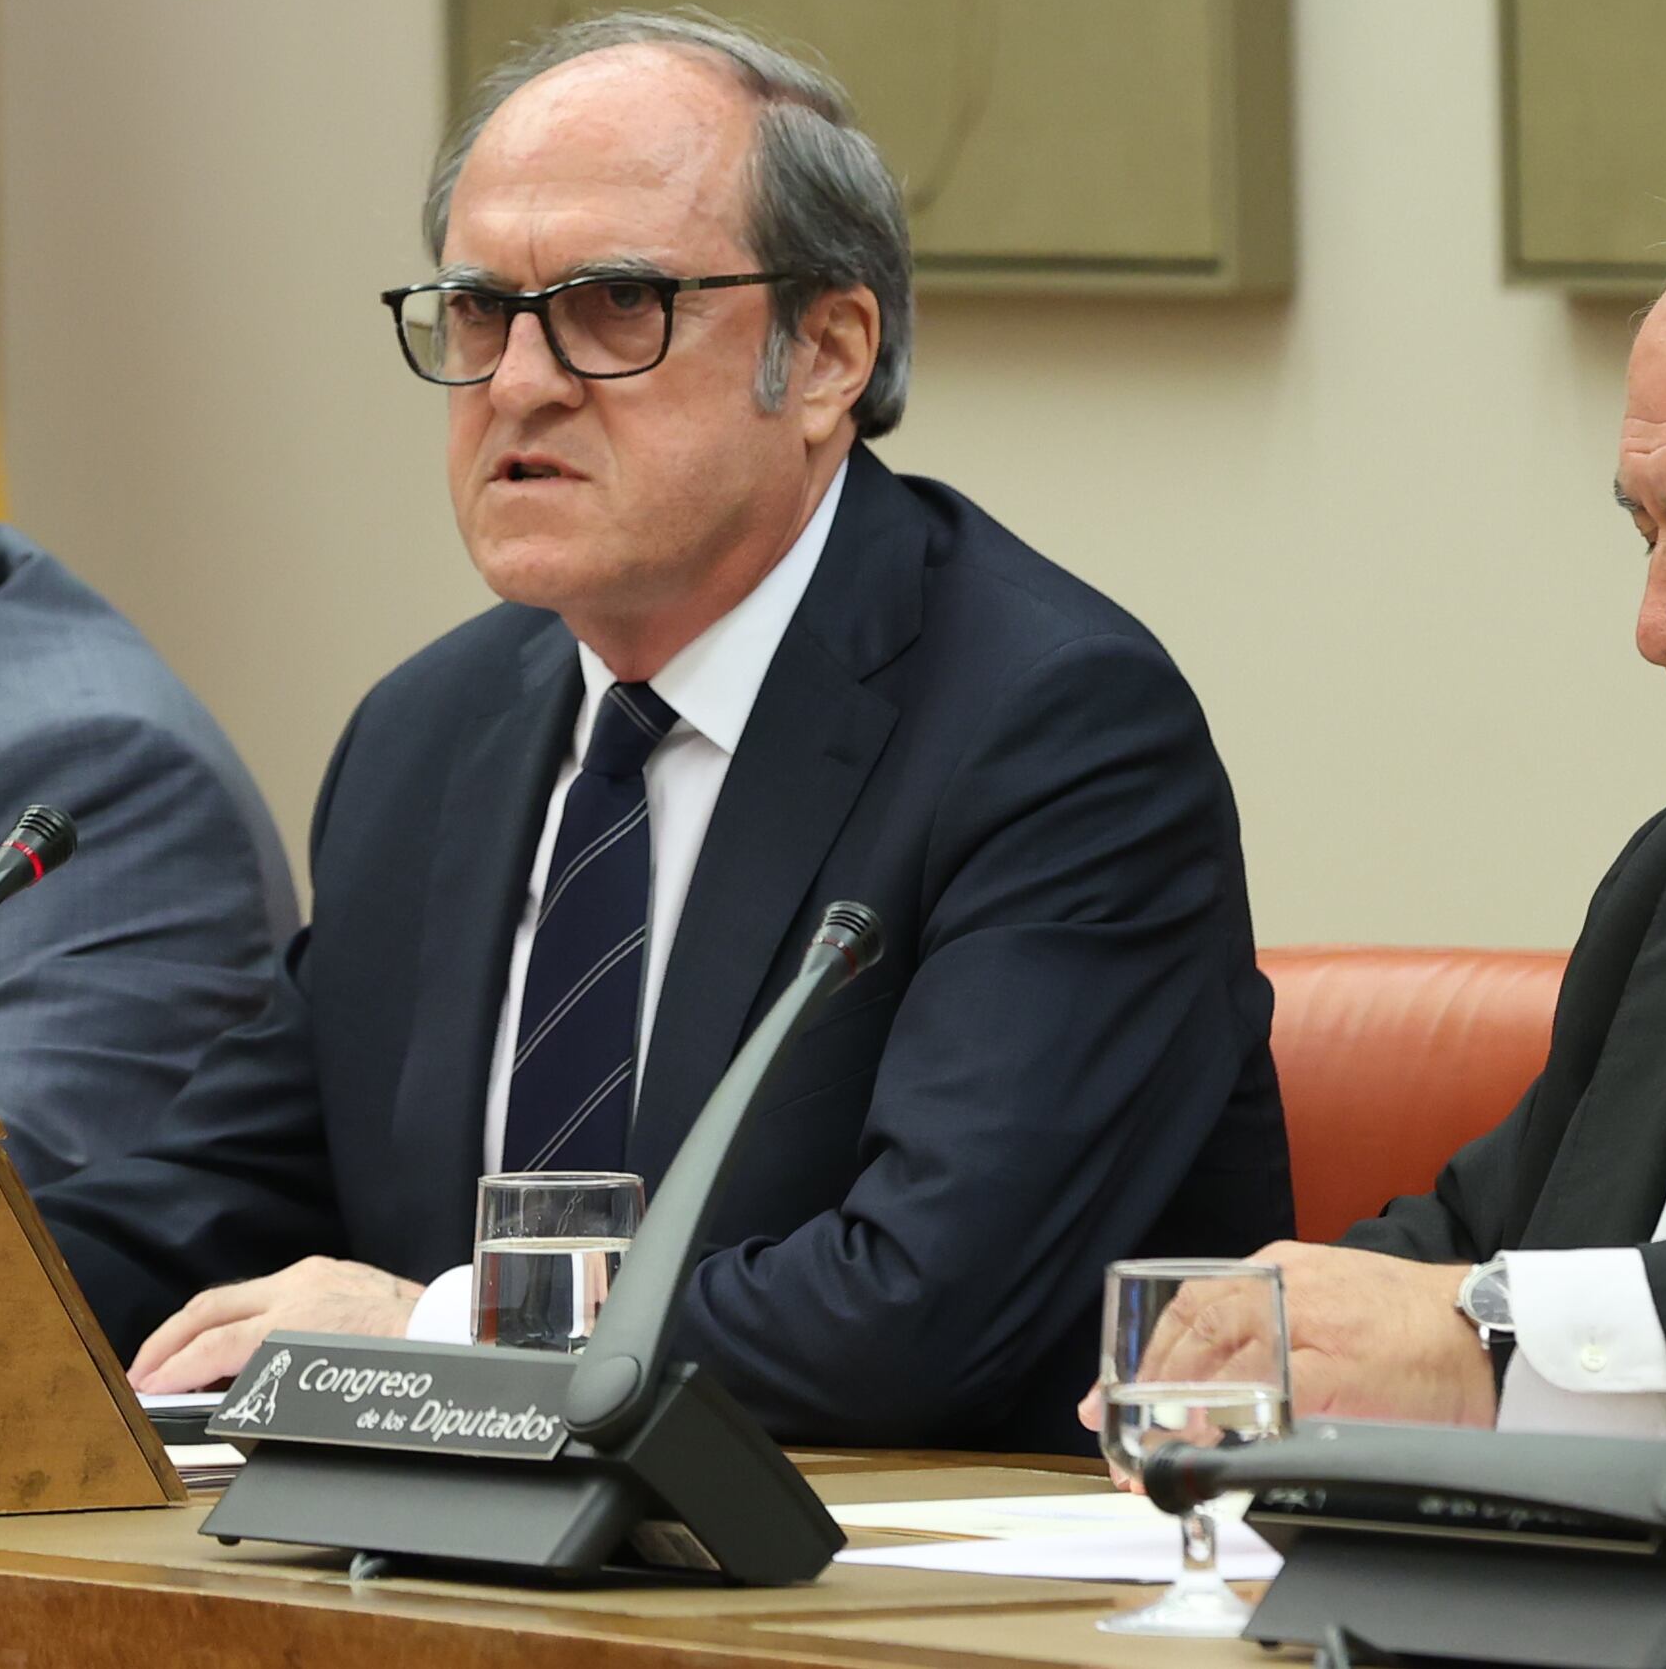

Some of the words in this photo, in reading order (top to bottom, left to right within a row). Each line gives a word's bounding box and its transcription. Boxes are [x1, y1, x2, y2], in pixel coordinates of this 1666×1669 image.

[298, 1358, 433, 1402] Congreso
[356, 1407, 381, 1429] de
[380, 1408, 408, 1431] los
[408, 1400, 560, 1442] Diputados
